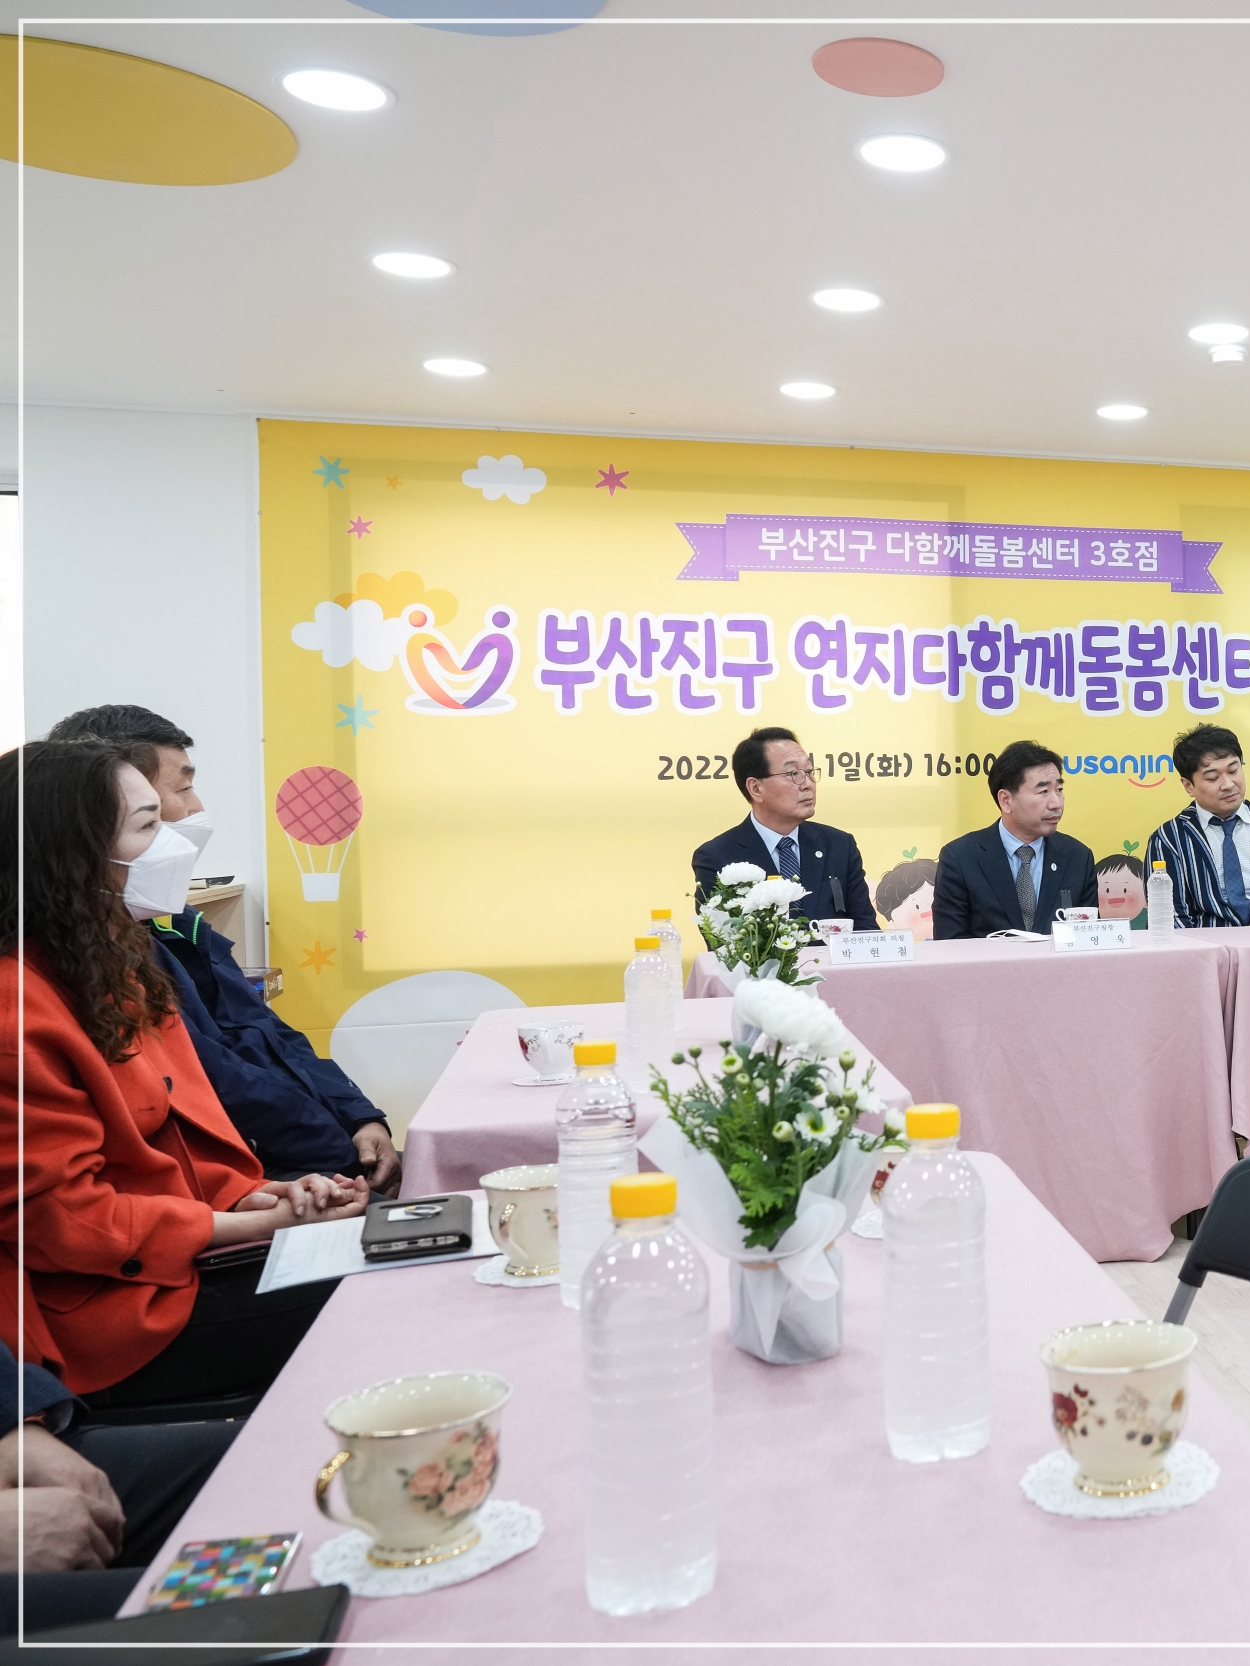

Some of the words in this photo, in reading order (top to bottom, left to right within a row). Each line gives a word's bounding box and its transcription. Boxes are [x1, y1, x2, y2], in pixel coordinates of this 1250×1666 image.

[757, 527, 877, 563] 부산진구
[885, 531, 1080, 570] 다함께돌봄센터
[1089, 538, 1159, 572] 3호점
[540, 614, 774, 710] 부산진구
[1063, 754, 1175, 781] usanjin
